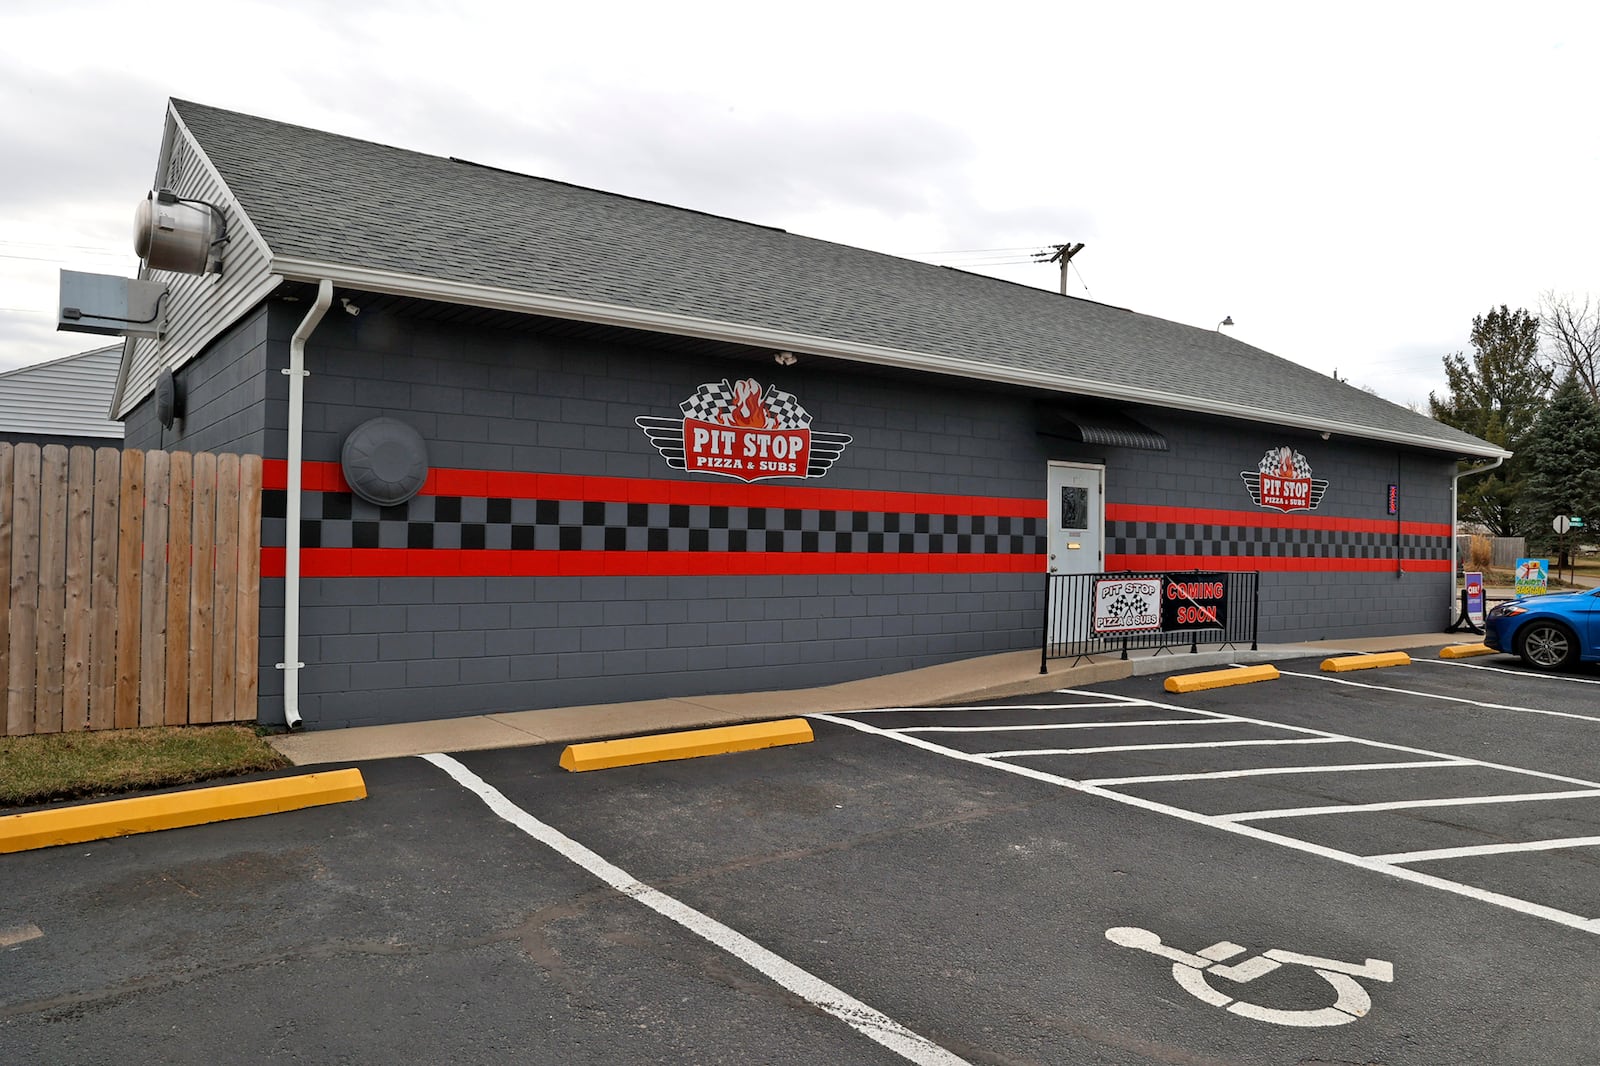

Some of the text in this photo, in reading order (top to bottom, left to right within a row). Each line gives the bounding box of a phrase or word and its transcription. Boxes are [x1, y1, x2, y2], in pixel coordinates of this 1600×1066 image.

[693, 428, 803, 459] PIT STOP
[697, 456, 797, 472] PIZZA & SUBS
[1264, 479, 1308, 498] PIT STOP
[1102, 583, 1155, 599] PIT STOP
[1167, 582, 1224, 600] COMING
[1097, 614, 1157, 628] PIZZA & SUBS
[1177, 606, 1217, 624] SOON
